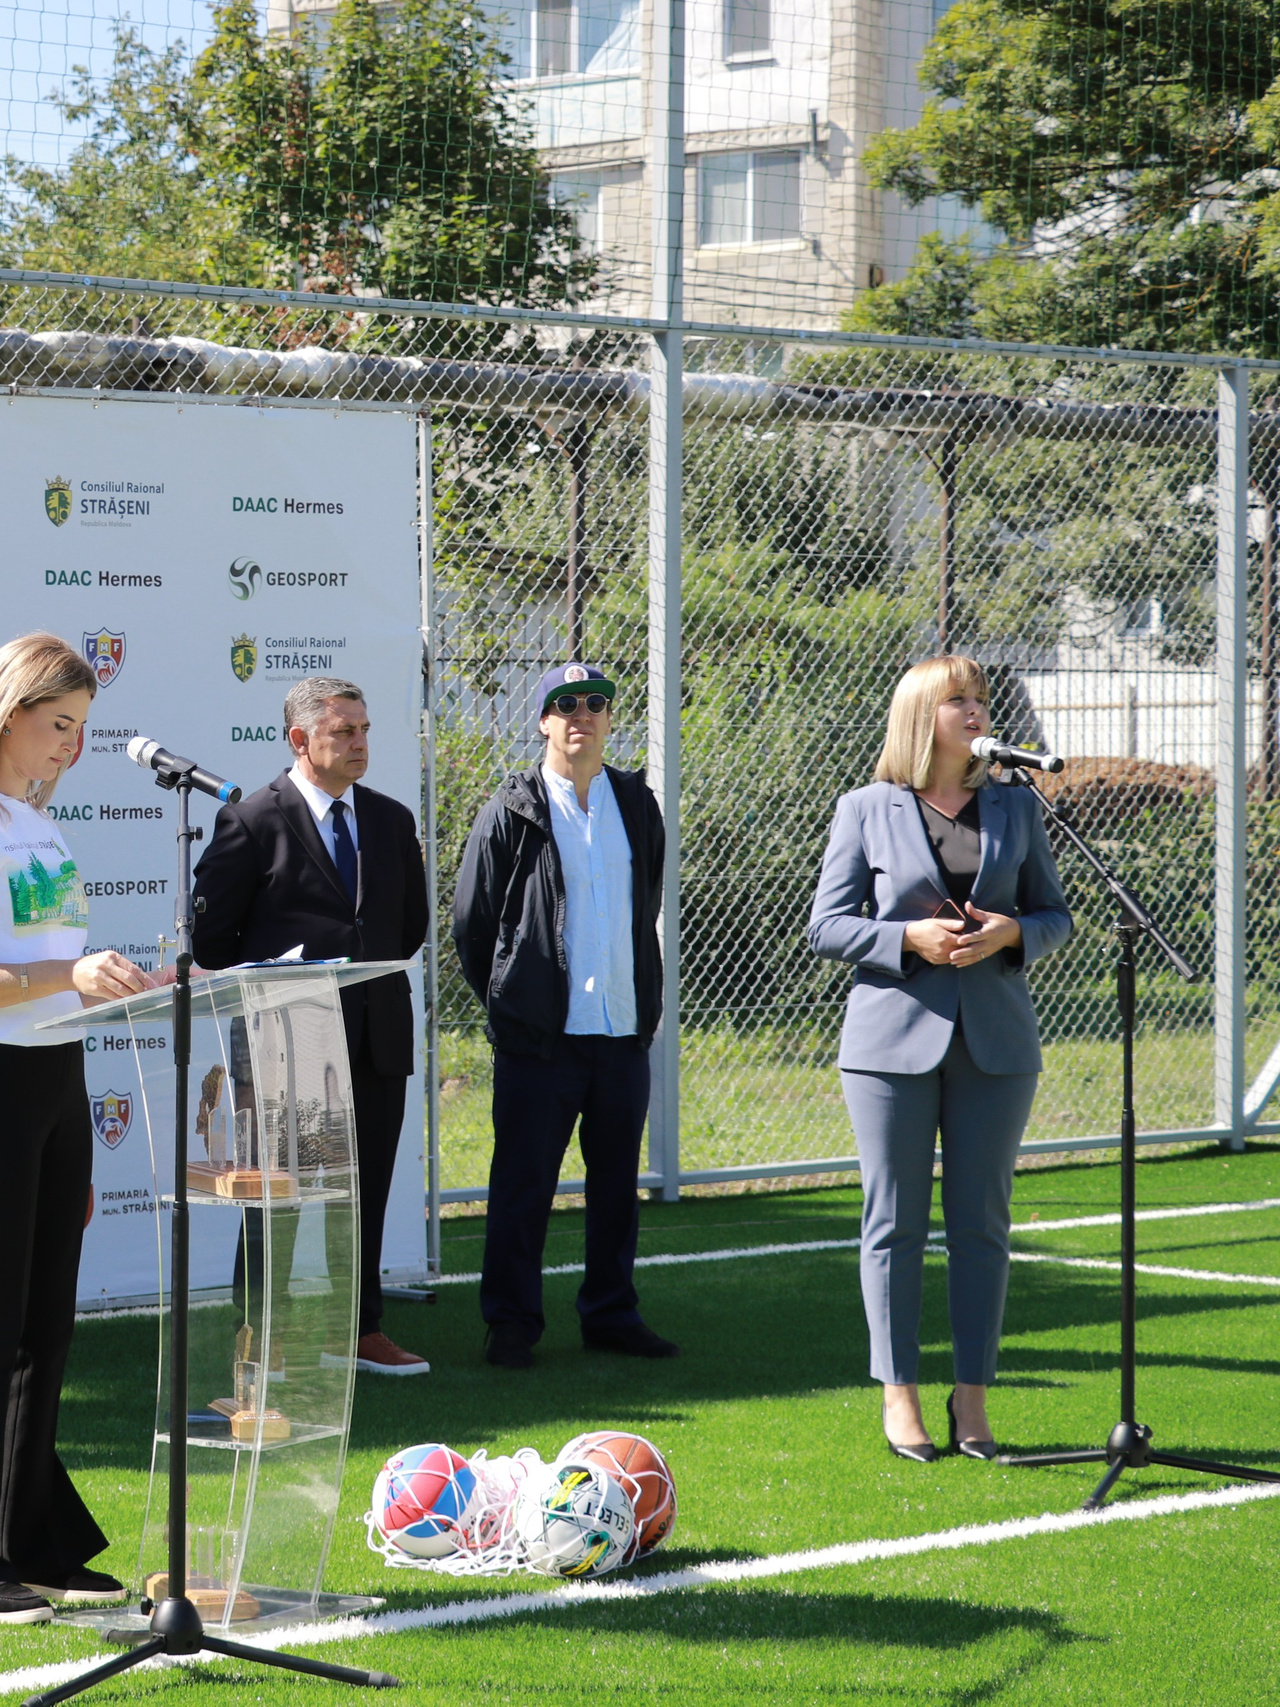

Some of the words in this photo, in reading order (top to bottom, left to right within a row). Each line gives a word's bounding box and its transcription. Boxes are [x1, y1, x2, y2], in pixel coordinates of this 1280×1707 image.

[81, 481, 124, 493] Consiliul
[127, 482, 165, 494] Raional
[80, 497, 150, 519] STRĂȘENI
[232, 497, 278, 513] DAAC
[284, 498, 344, 515] Hermes
[45, 569, 92, 586] DAAC
[98, 571, 162, 588] Hermes
[266, 571, 348, 587] GEOSPORT
[265, 637, 307, 648] Consiliul
[310, 637, 346, 648] Raional
[265, 652, 332, 673] STRĂȘENI
[92, 729, 139, 739] PRIMARIA
[232, 726, 277, 742] DAAC
[46, 805, 93, 821] DAAC
[100, 804, 163, 820] Hermes
[84, 880, 168, 897] GEOSPORT
[103, 1035, 166, 1052] Hermes
[102, 1188, 150, 1202] PRIMARIA
[102, 1208, 121, 1216] MUN.
[122, 1200, 170, 1214] STRĂȘNI
